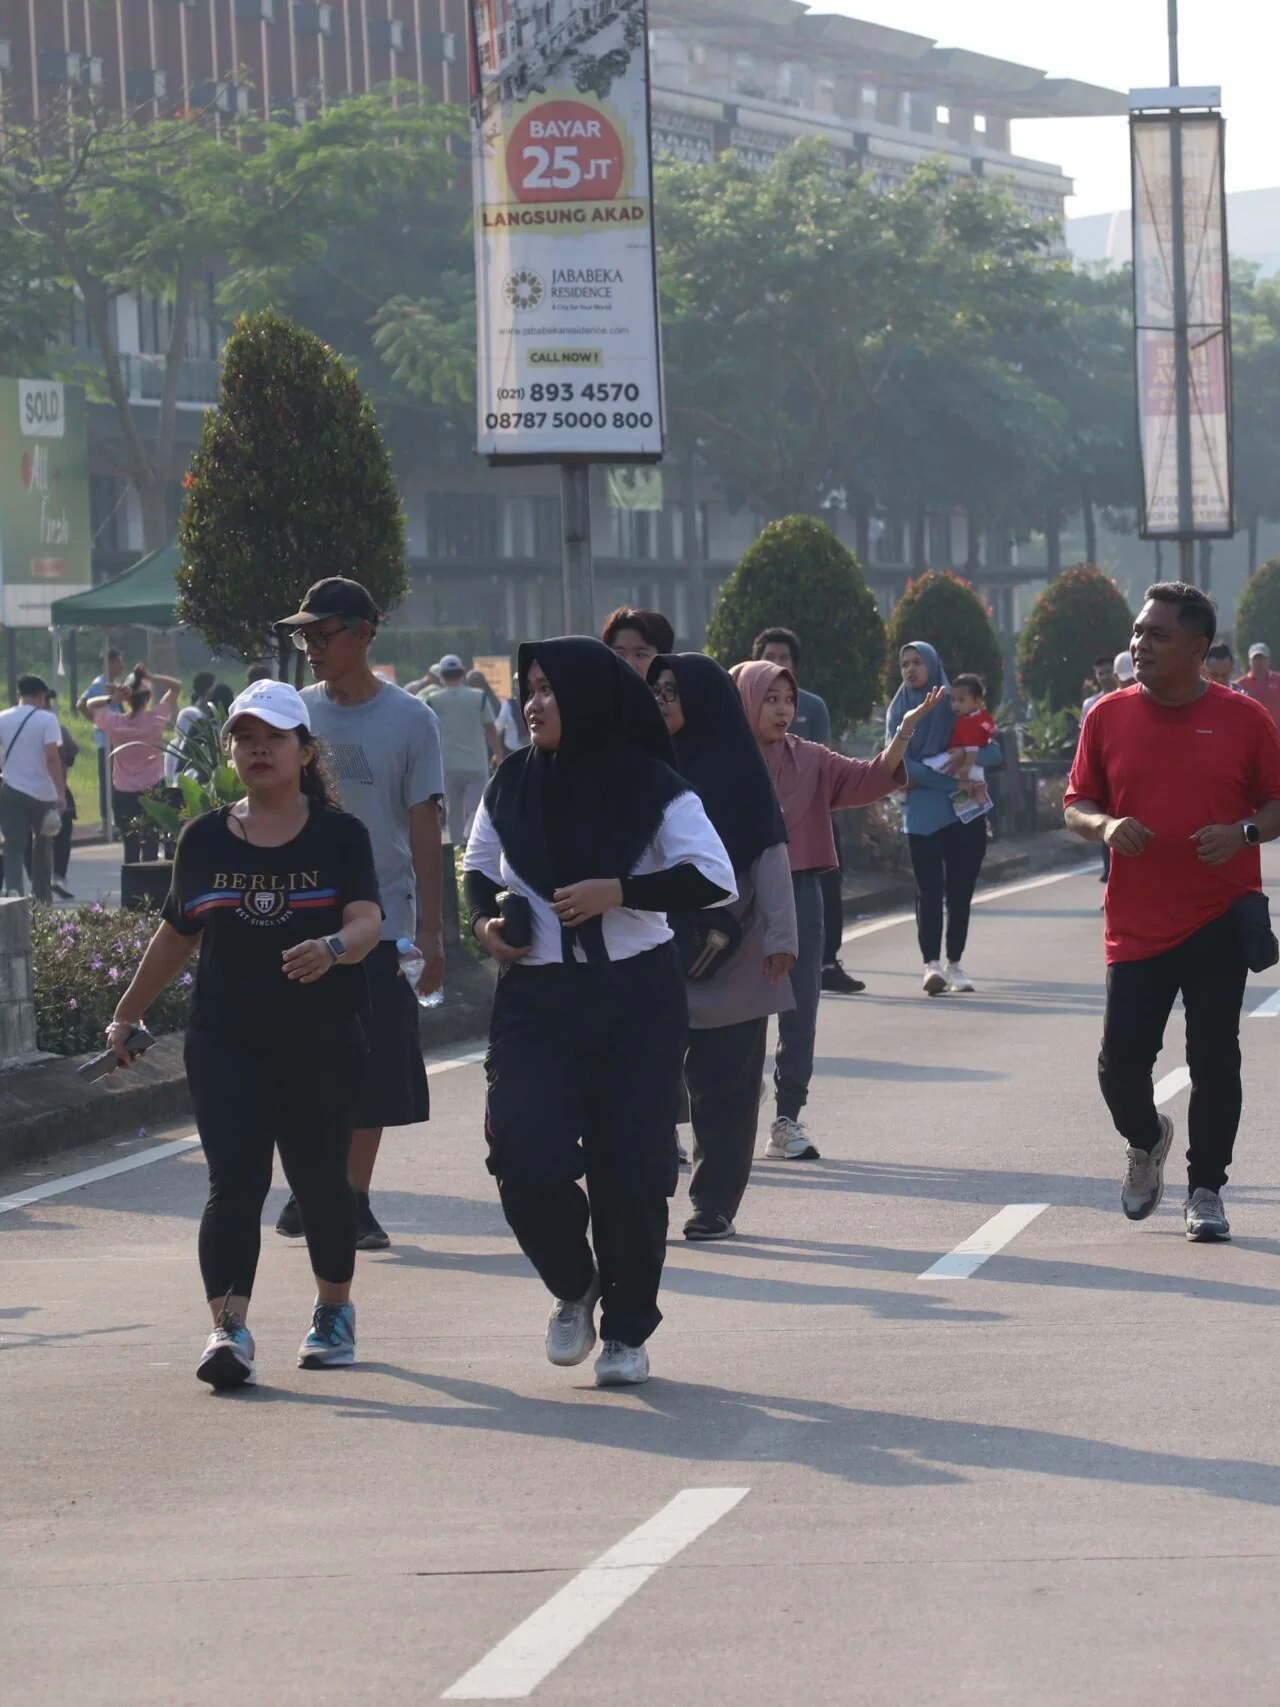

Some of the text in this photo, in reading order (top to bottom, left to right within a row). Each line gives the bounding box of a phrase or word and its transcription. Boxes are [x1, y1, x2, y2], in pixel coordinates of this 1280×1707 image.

[529, 120, 601, 138] BAYAR
[482, 206, 644, 227] LANGSUNG AKAD
[551, 268, 623, 284] JABABEKA
[550, 286, 612, 298] RESIDENCE
[530, 352, 560, 362] CALL
[562, 352, 593, 362] NOW
[497, 383, 640, 402] (021) 893 4570
[25, 389, 59, 424] SOLD
[485, 411, 653, 429] 08787 5000 800
[213, 871, 319, 889] BERLIN
